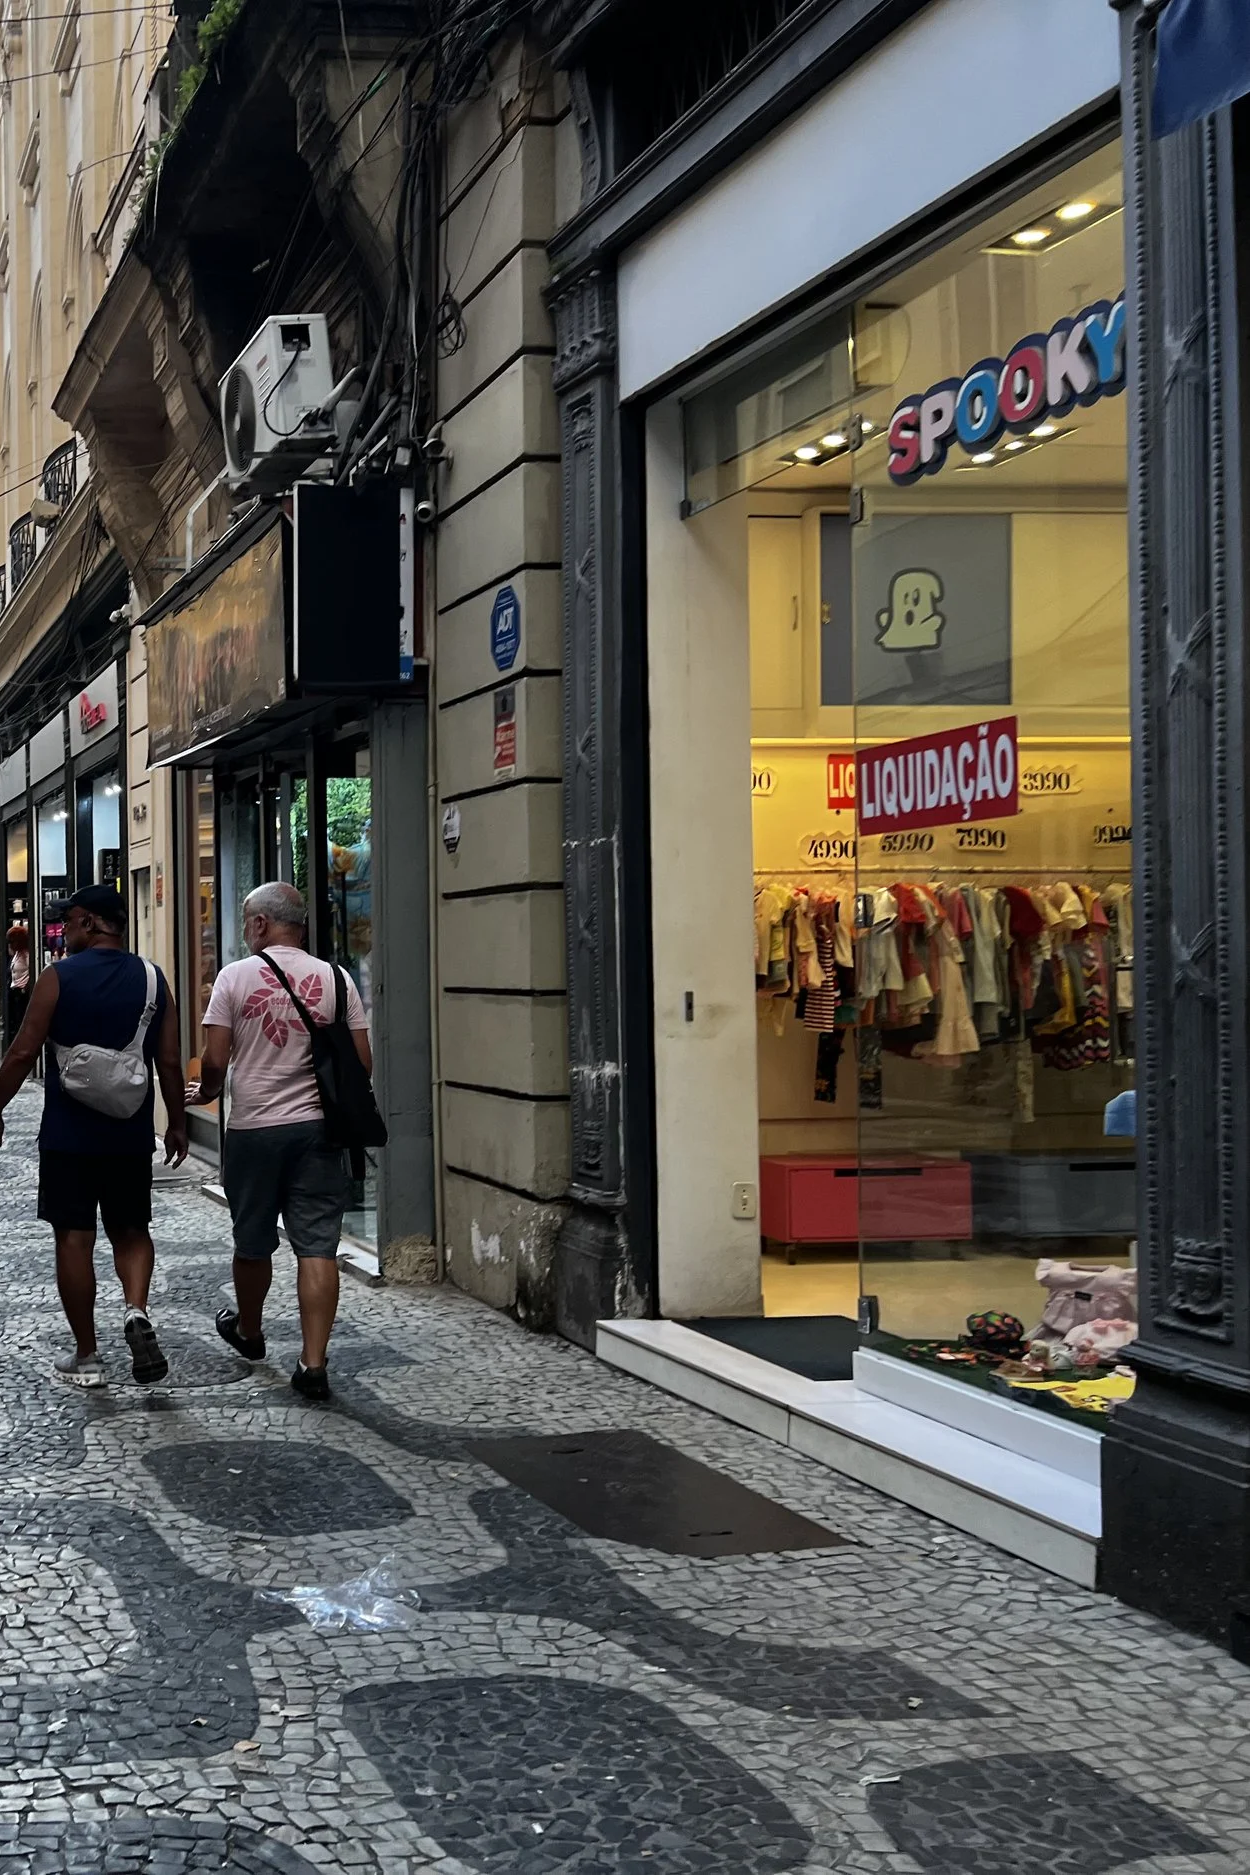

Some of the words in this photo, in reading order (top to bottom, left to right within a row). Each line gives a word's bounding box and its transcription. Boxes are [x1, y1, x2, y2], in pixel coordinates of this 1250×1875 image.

[887, 300, 1127, 474] SPOOKY
[496, 606, 515, 635] ADT
[861, 725, 1014, 820] LIQUIDAÇÃO
